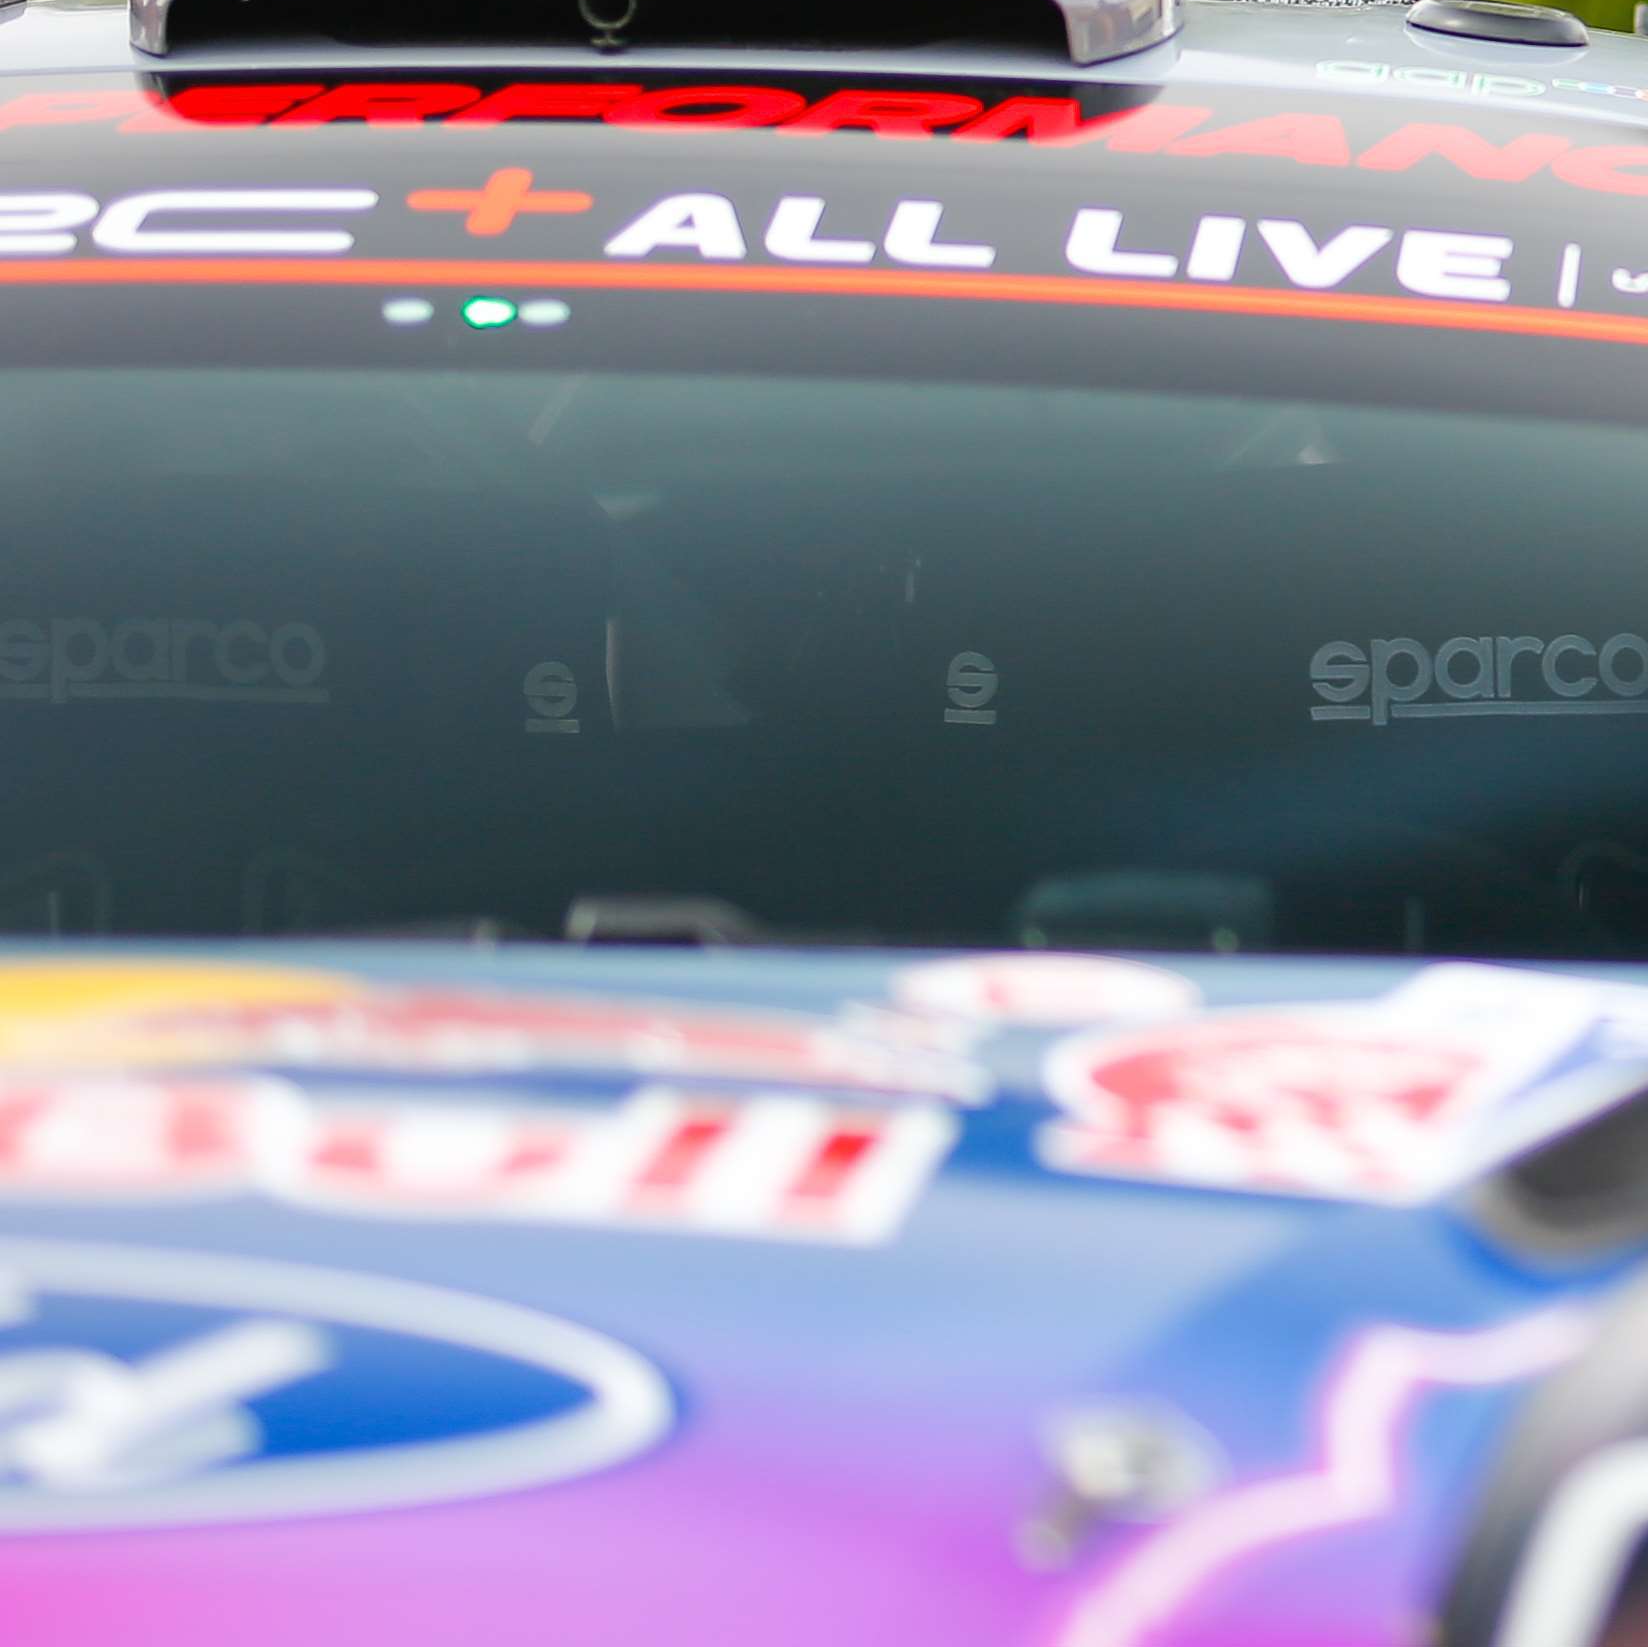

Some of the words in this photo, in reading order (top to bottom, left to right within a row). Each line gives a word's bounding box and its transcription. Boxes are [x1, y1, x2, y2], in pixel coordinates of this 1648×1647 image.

[603, 193, 997, 267] ALL
[1064, 208, 1512, 302] LIVE
[0, 616, 331, 704] sparco
